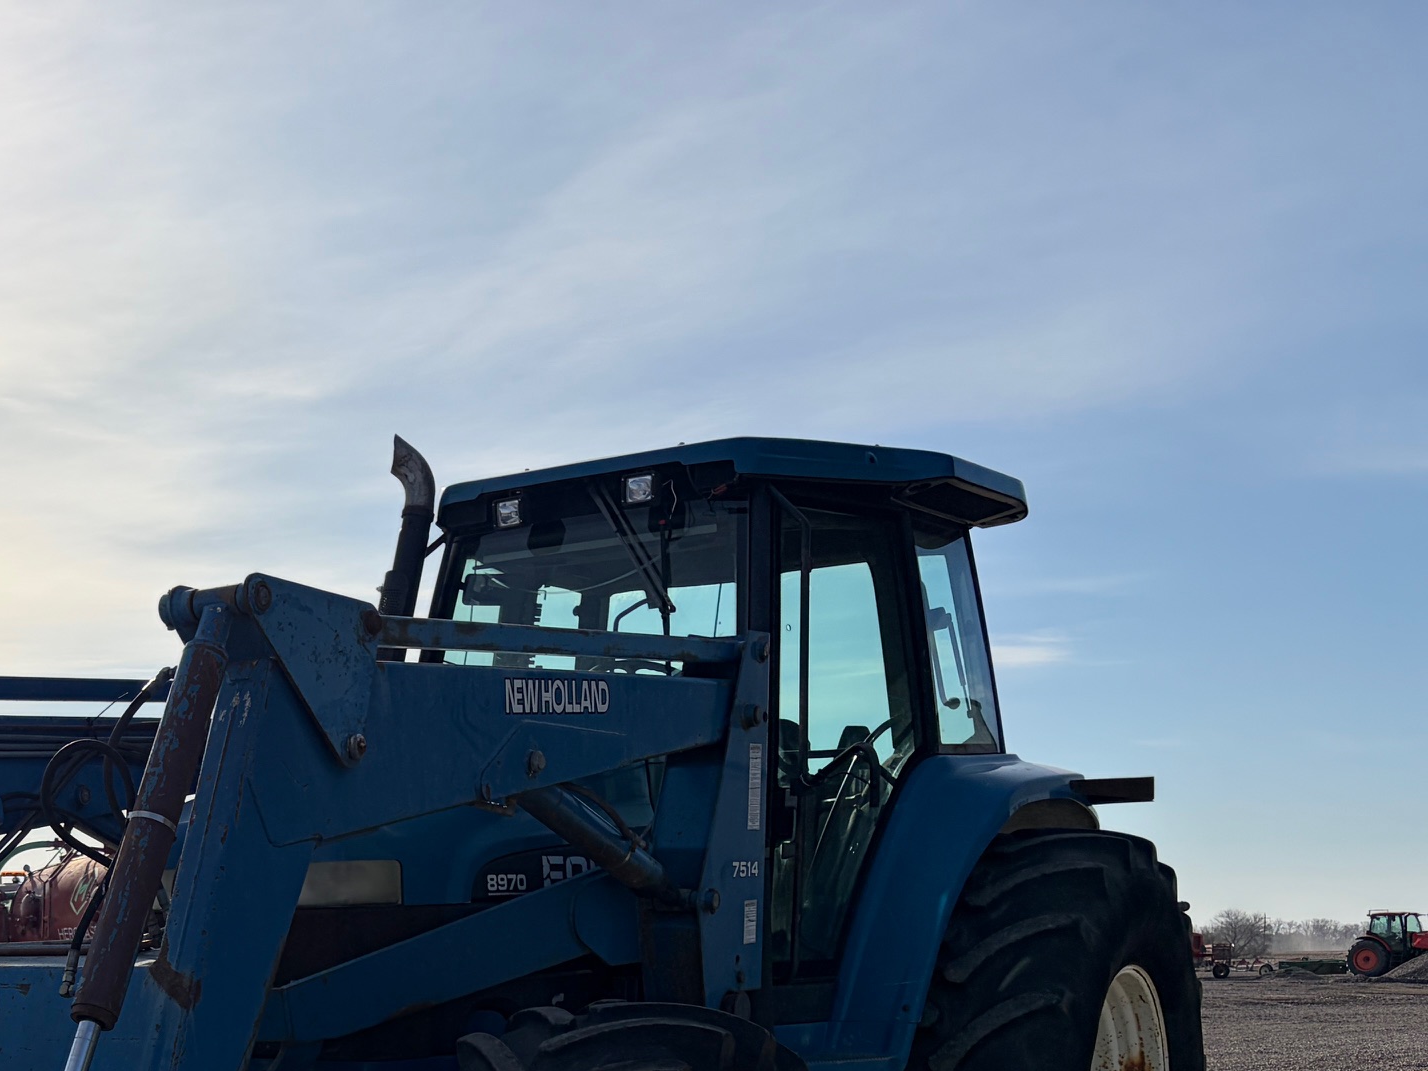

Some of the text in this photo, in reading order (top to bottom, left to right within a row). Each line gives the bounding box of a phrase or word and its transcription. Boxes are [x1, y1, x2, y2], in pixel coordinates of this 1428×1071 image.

[504, 678, 611, 714] NEW HOLLAND
[541, 855, 596, 888] FO
[732, 861, 759, 877] 7514
[486, 873, 527, 891] 8970
